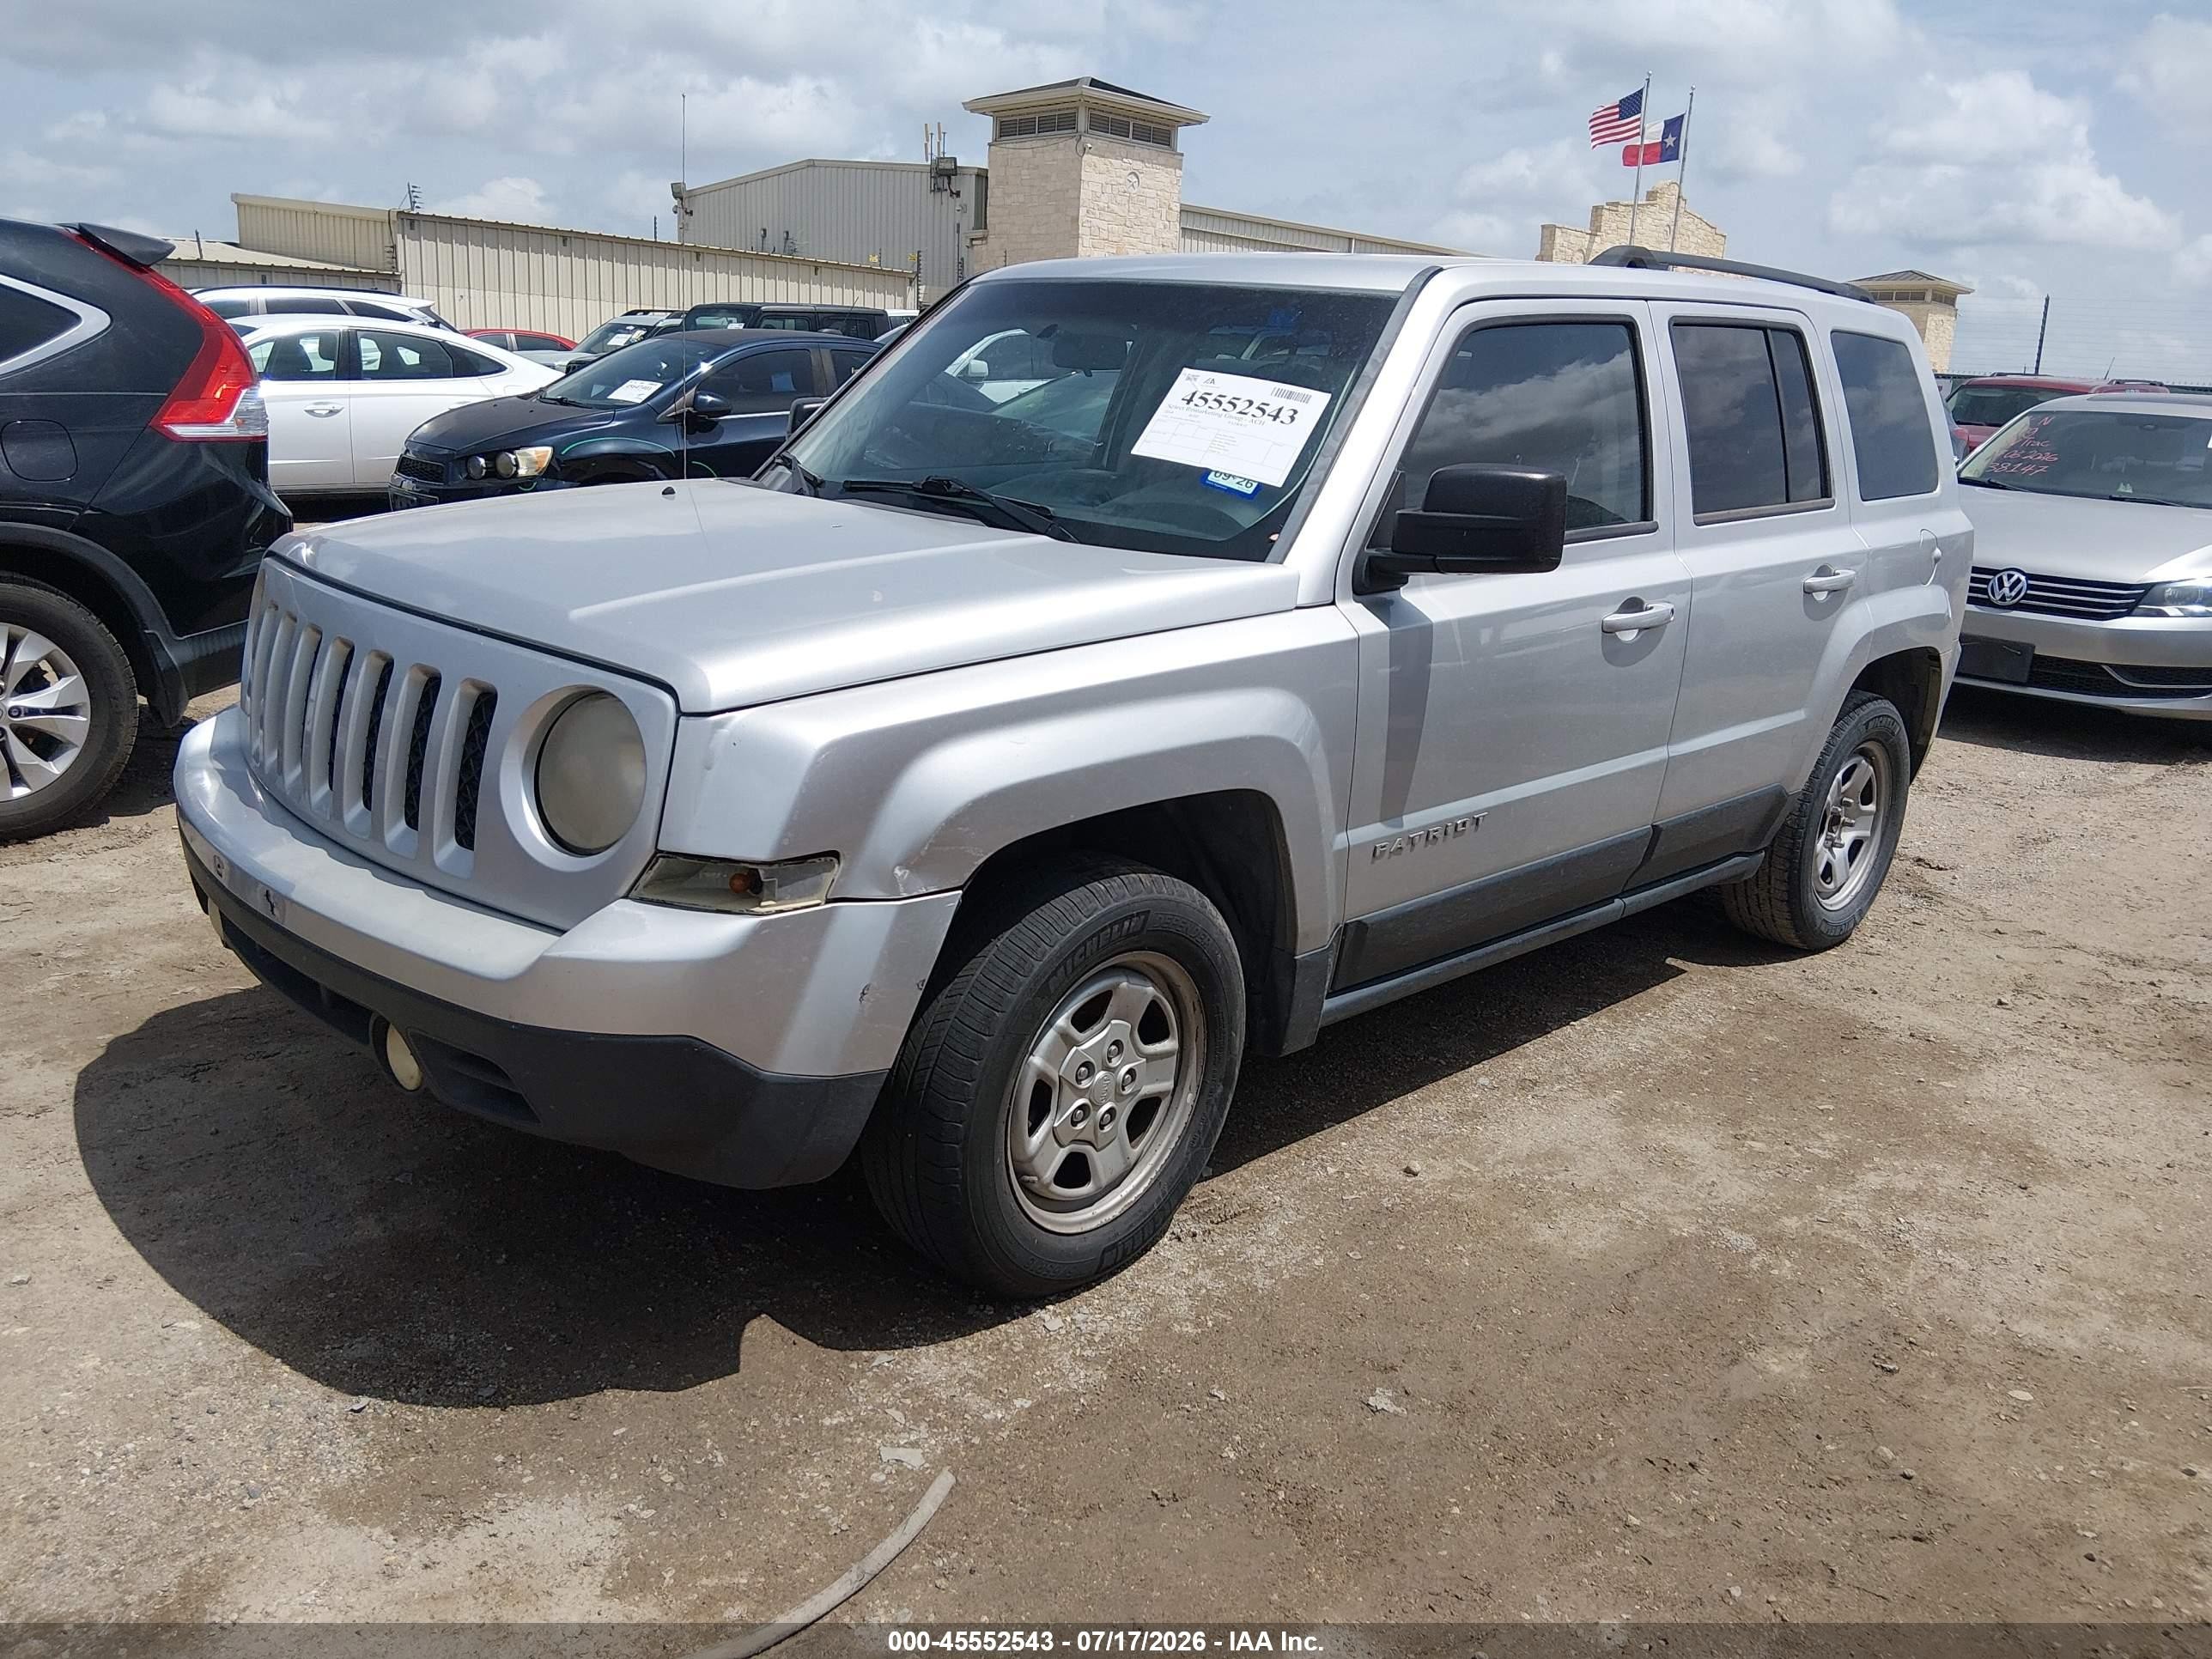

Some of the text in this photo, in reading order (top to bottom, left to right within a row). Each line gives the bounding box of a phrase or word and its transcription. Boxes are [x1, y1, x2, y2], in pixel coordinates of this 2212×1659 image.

[1182, 390, 1298, 425] 45552543
[1372, 811, 1489, 860] PATRIOT
[1044, 915, 1148, 994] MICHELIN
